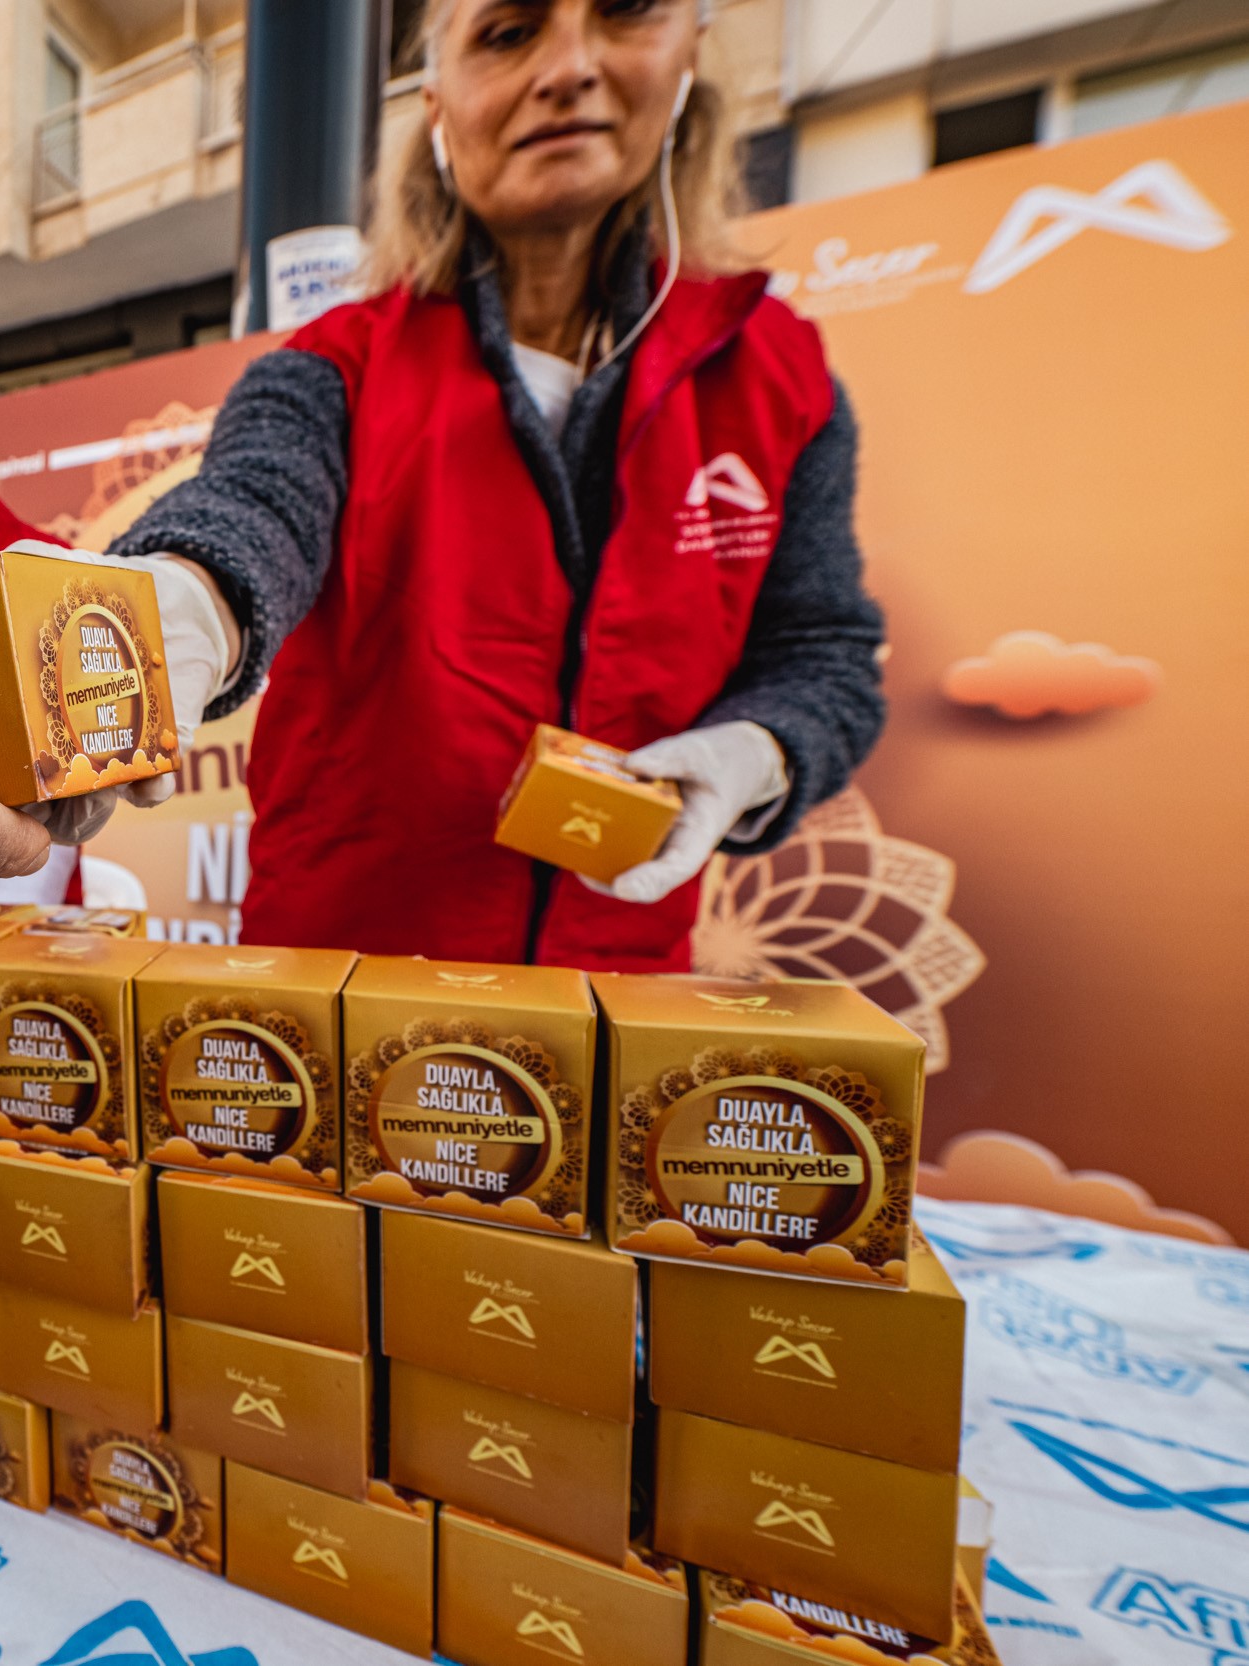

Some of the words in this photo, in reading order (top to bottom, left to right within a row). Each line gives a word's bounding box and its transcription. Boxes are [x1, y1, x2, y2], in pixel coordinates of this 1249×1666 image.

[81, 626, 118, 650] DUAYLA,
[66, 674, 135, 706] memnuniyetle
[97, 703, 118, 727] NİCE
[82, 728, 133, 754] KANDİLLERE
[203, 1038, 265, 1063] DUAYLA,
[426, 1064, 501, 1094] DUAYLA,
[171, 1086, 293, 1105] memnuniyetle
[214, 1105, 250, 1128] NİCE
[383, 1116, 533, 1139] memnuniyetle
[718, 1098, 812, 1131] DUAYLA,
[187, 1123, 276, 1152] KANDİLLERE
[436, 1138, 477, 1165] NİCE
[401, 1157, 510, 1192] KANDİLLERE
[663, 1158, 850, 1181] memnuniyetle
[729, 1181, 780, 1210] NİCE
[684, 1203, 818, 1240] KANDİLLERE
